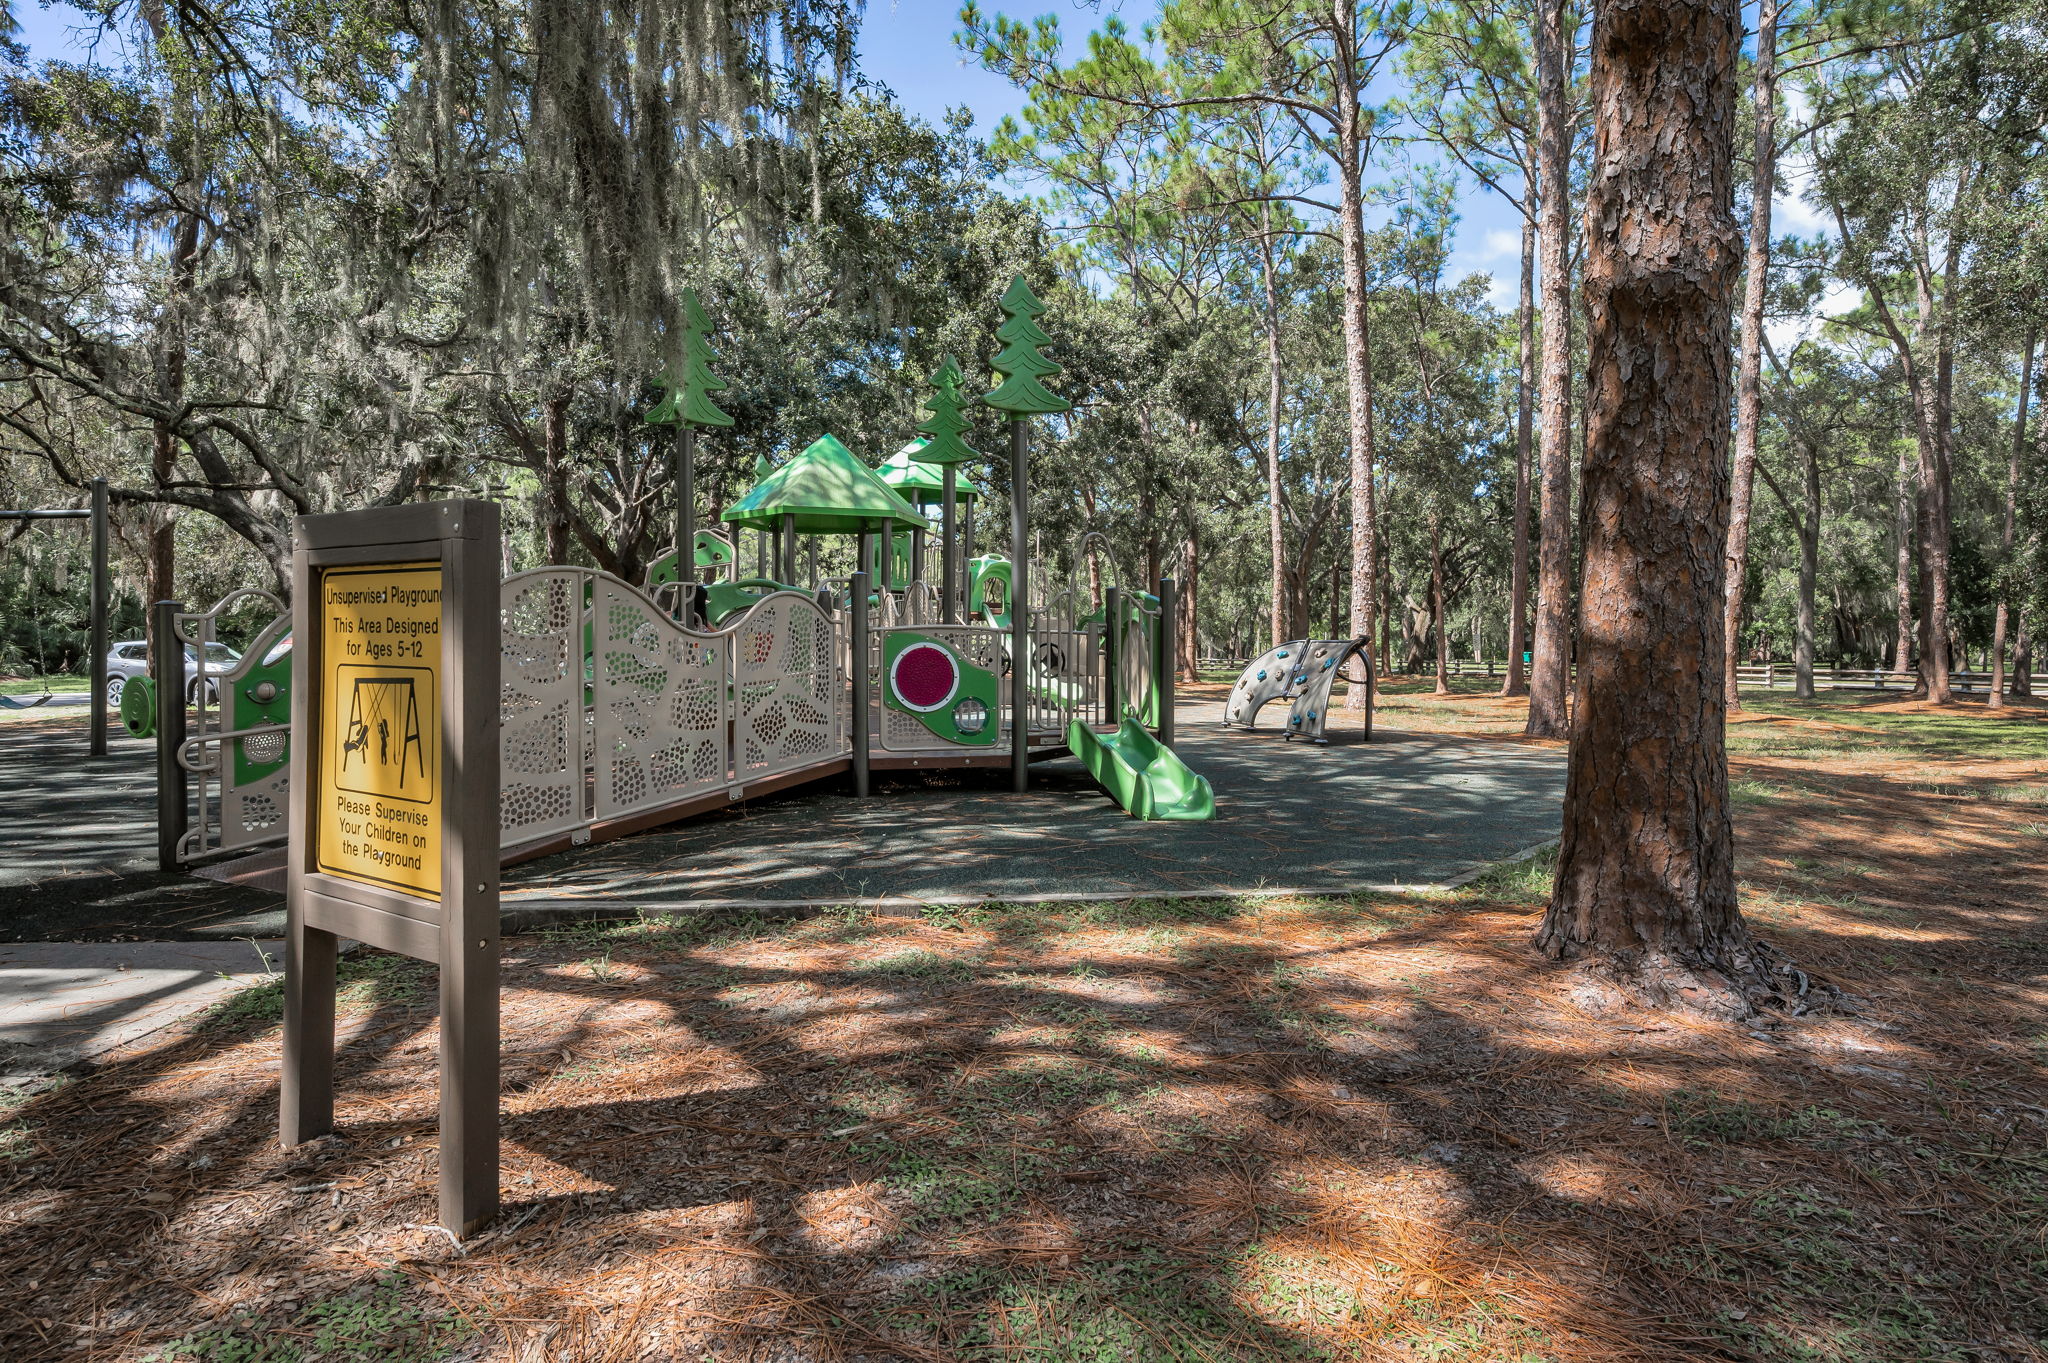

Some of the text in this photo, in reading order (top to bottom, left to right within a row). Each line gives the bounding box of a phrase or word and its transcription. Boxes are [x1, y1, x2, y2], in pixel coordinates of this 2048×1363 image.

[326, 586, 442, 608] Unsupervised Playgroun
[333, 617, 438, 637] This Area Designed
[347, 640, 423, 660] for Ages 5-12
[337, 796, 428, 826] Please Supervise
[339, 817, 426, 848] Your Children on
[342, 840, 421, 870] the Playground
